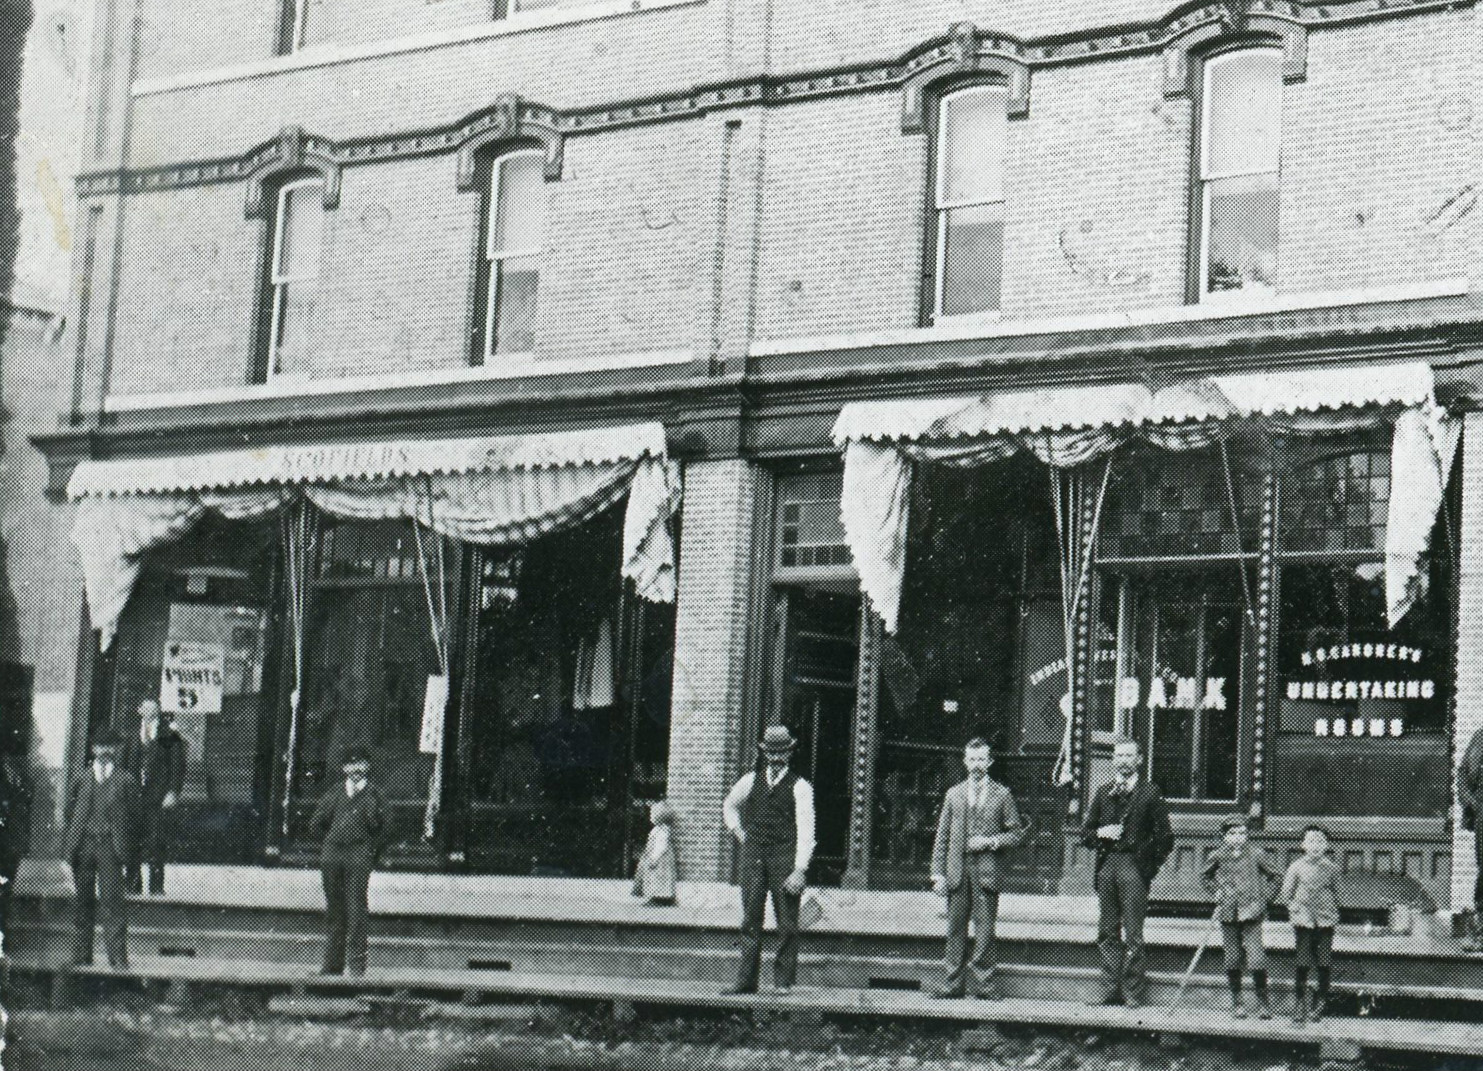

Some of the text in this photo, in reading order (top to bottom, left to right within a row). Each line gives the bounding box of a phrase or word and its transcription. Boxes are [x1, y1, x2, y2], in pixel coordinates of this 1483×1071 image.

[1117, 677, 1227, 710] BANK
[1286, 680, 1436, 700] UNDERTAKING
[1315, 718, 1403, 737] ROOMS
